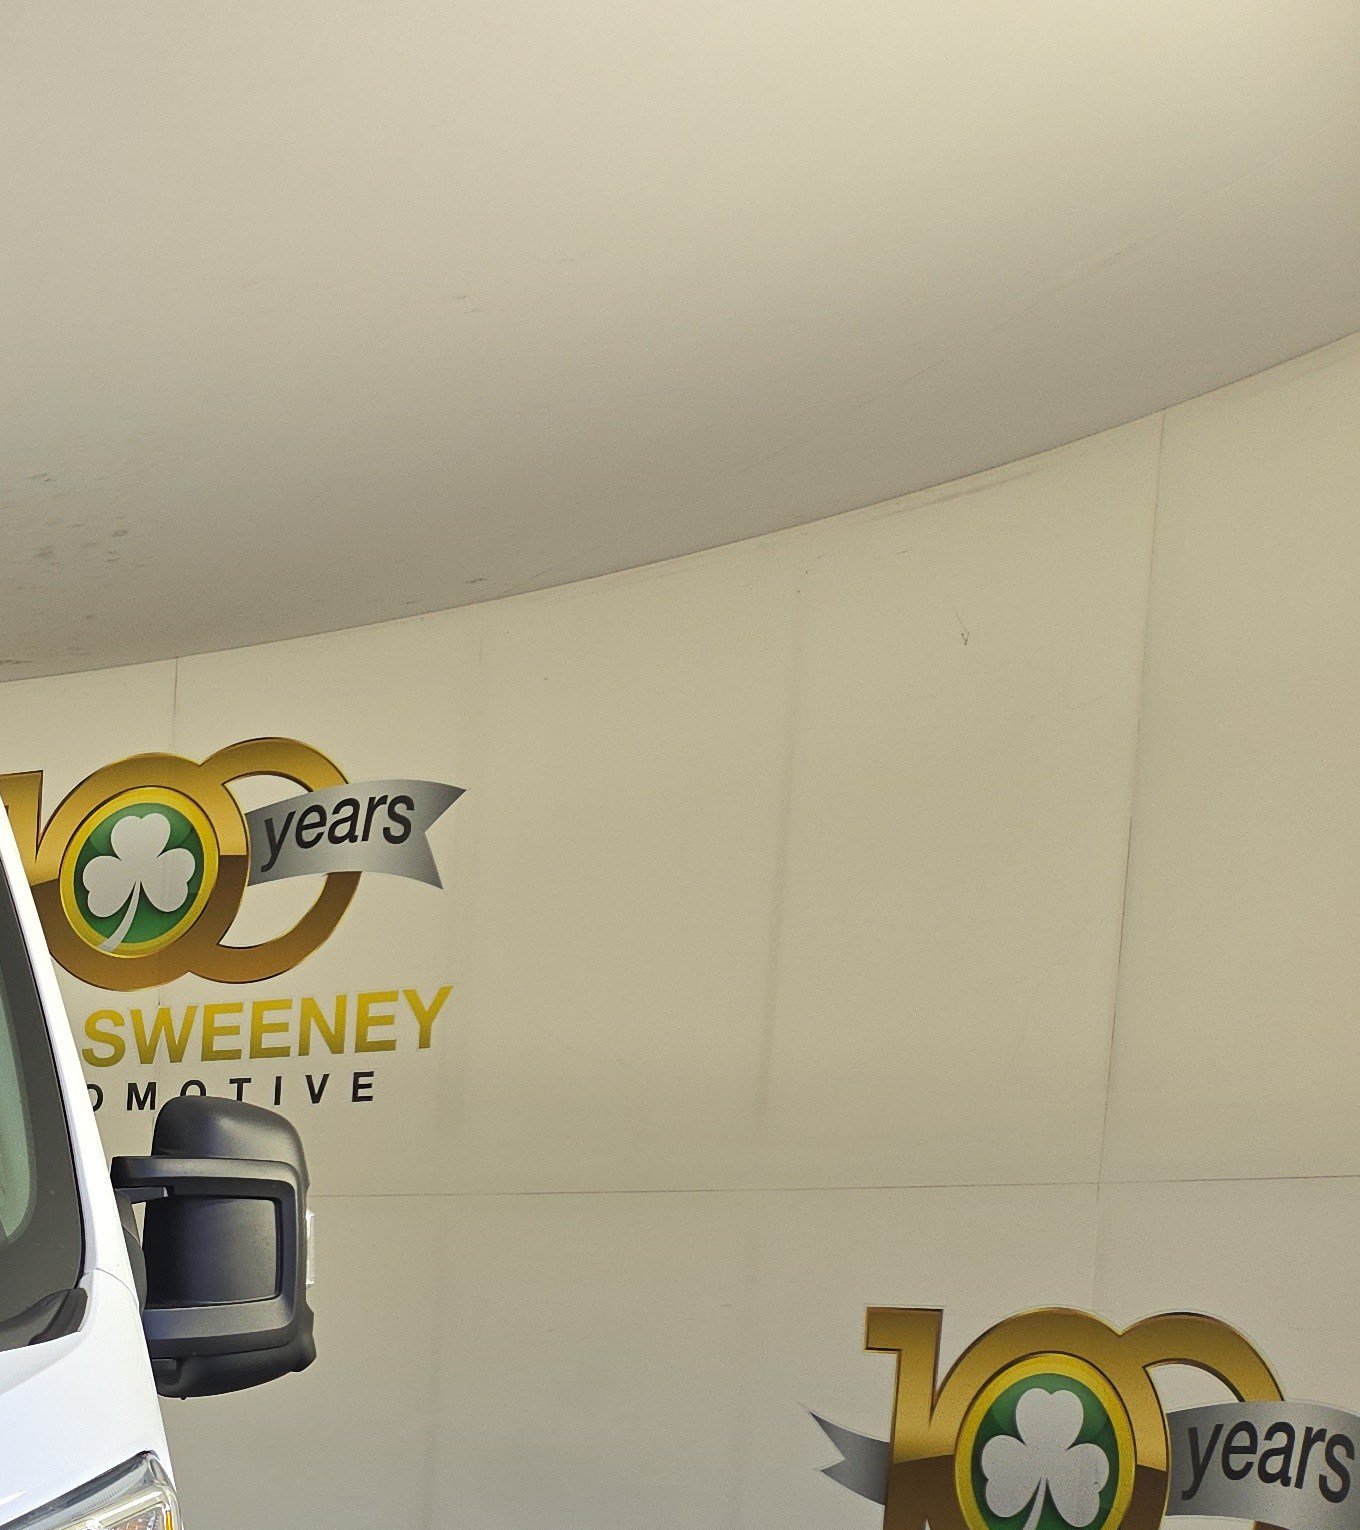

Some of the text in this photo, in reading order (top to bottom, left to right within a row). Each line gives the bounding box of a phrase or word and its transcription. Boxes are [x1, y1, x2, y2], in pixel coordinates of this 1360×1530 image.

[261, 795, 414, 873] years
[81, 986, 454, 1067] SWEENEY
[1181, 1420, 1356, 1505] years
